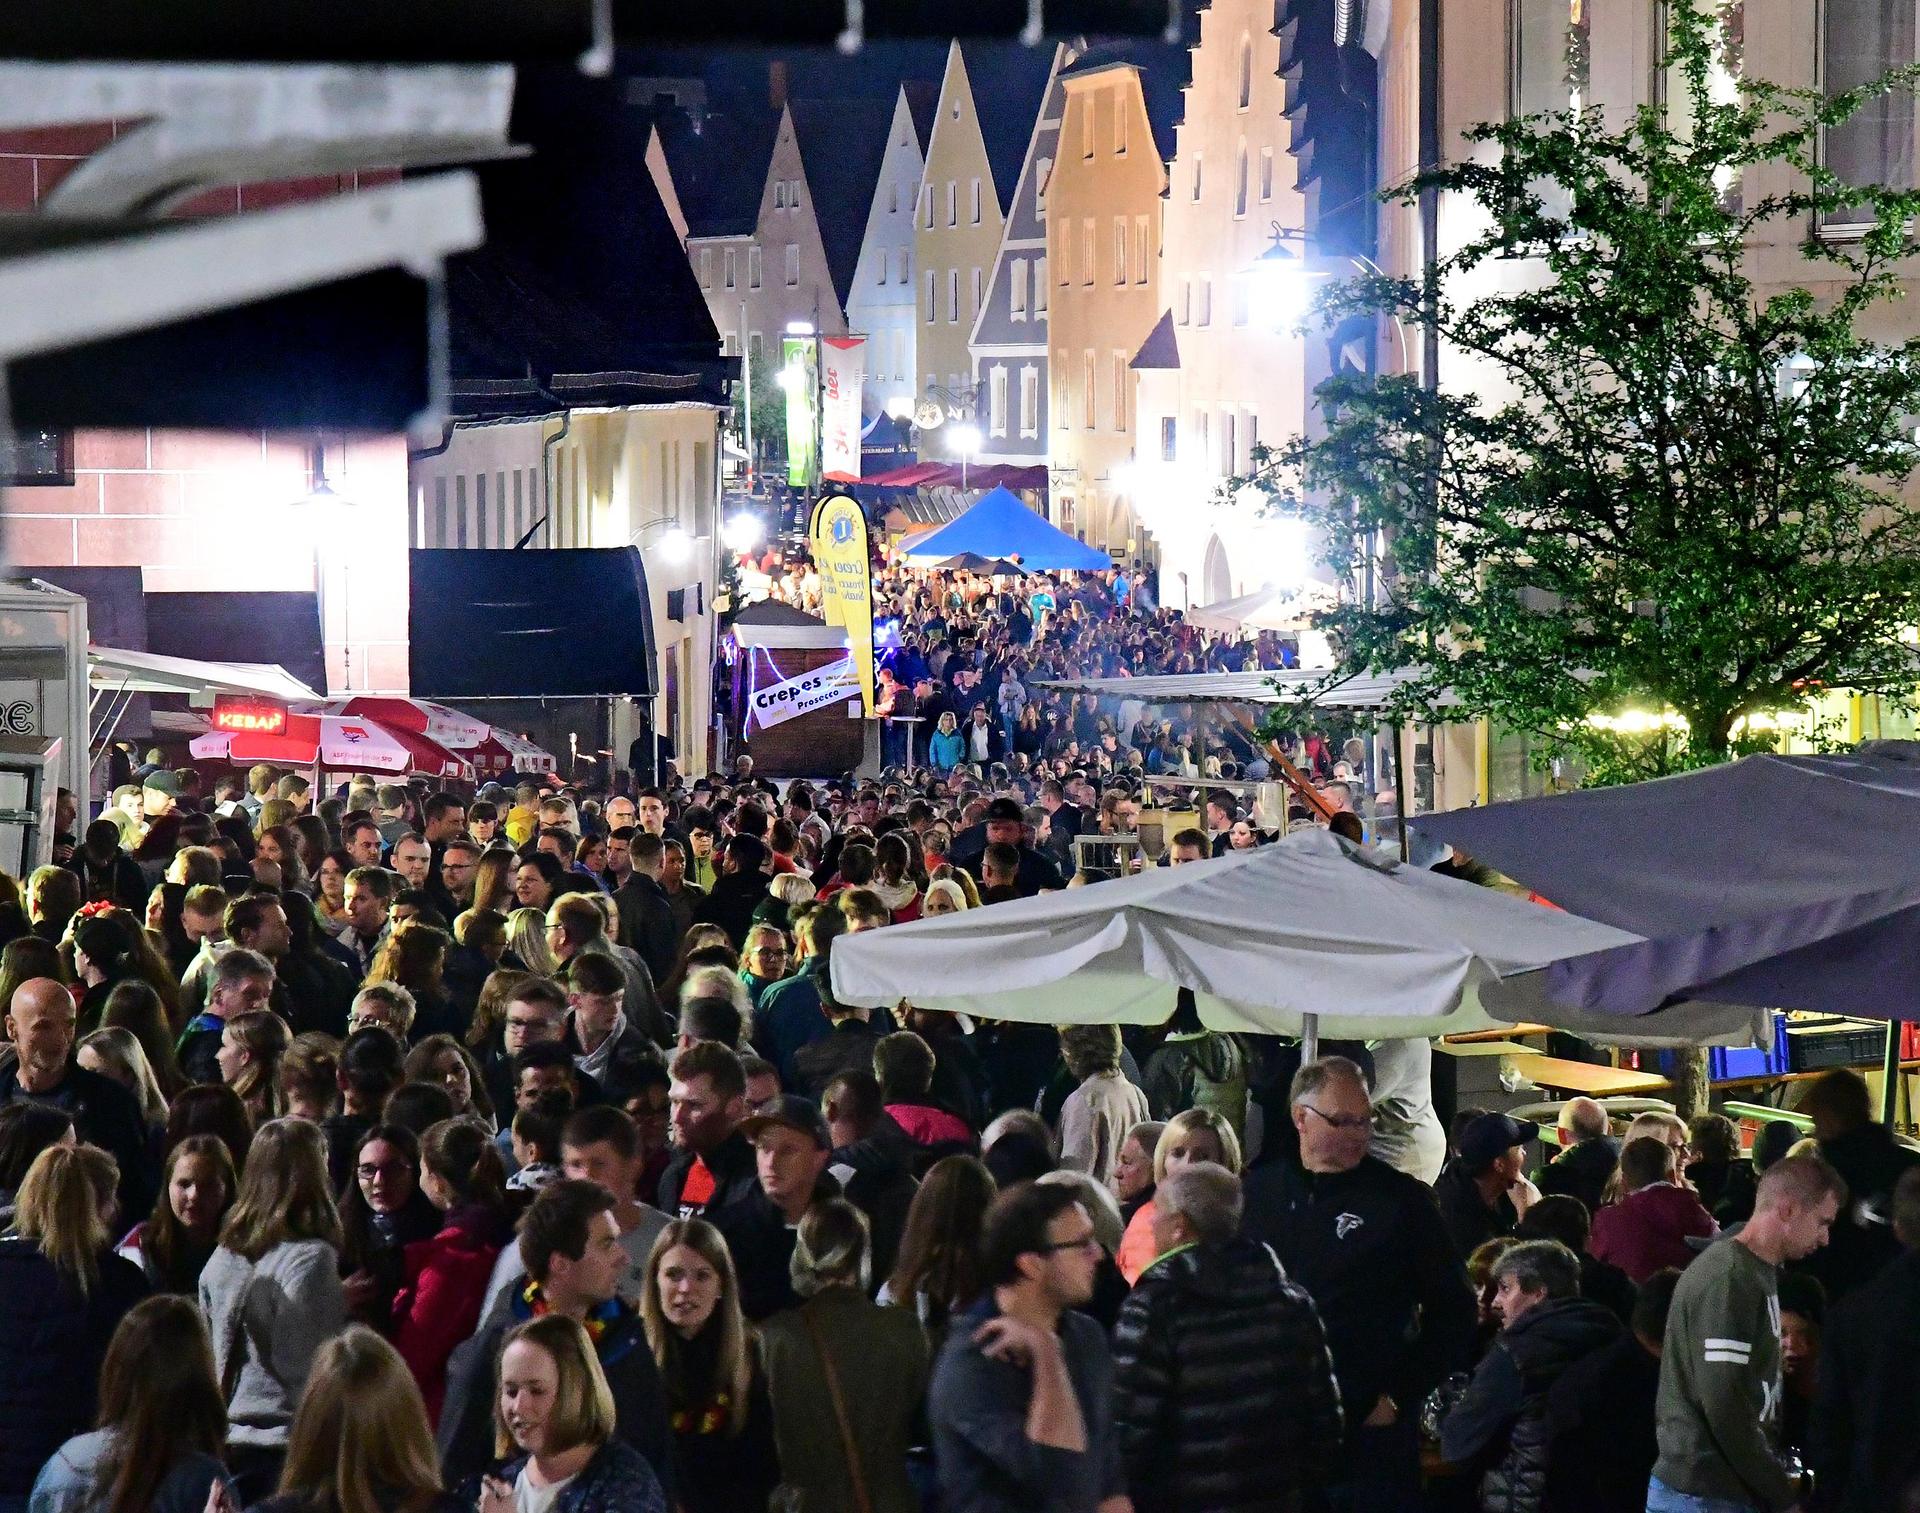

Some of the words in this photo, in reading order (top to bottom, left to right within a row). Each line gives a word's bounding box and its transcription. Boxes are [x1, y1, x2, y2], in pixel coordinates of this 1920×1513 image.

[756, 677, 822, 709] Crepes
[797, 689, 839, 710] Prosecco
[219, 713, 283, 730] KEBAP
